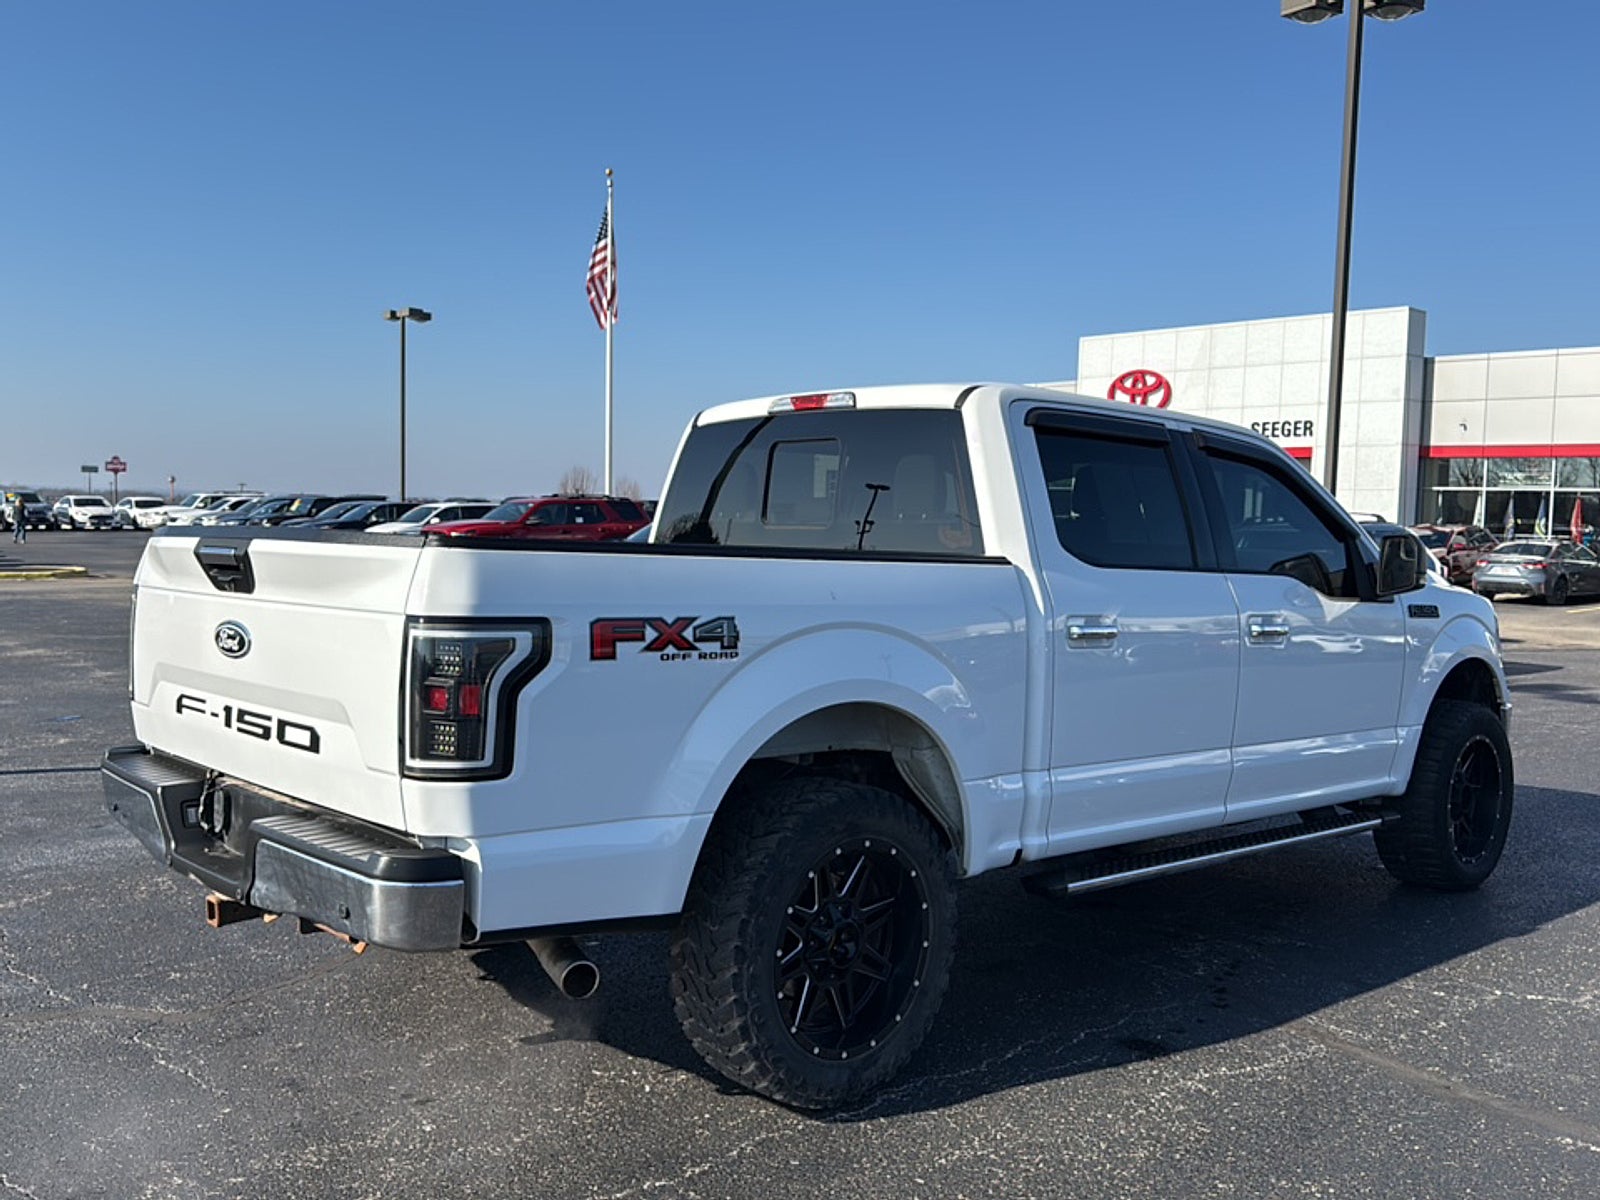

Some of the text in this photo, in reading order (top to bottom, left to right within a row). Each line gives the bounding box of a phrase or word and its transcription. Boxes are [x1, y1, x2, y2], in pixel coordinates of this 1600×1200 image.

[1251, 420, 1314, 438] SEEGER
[590, 616, 740, 660] FX4
[660, 651, 739, 661] OFF ROAD
[176, 693, 320, 754] F-150
